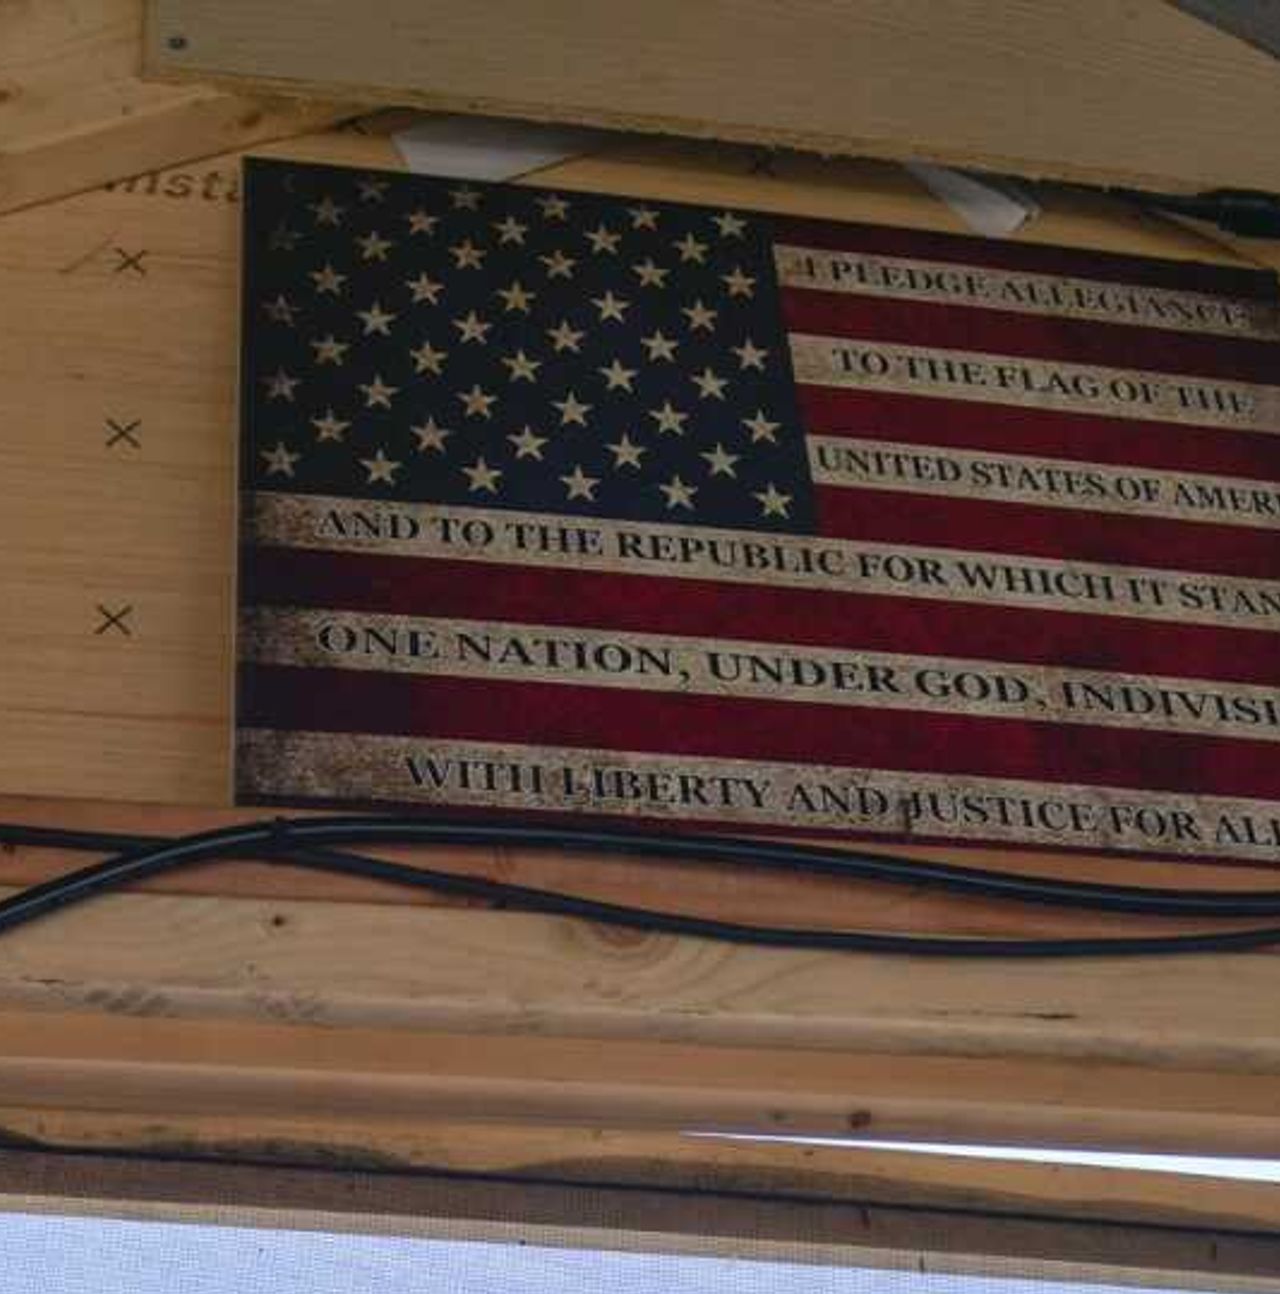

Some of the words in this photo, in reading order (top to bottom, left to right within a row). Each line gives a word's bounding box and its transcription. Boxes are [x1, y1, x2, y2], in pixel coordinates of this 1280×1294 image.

[831, 259, 988, 300] PLEDGE
[1001, 278, 1253, 327] ALLEGIANCE
[832, 346, 889, 375] TO
[893, 353, 987, 387] THE
[996, 363, 1099, 398] FLAG
[1110, 379, 1163, 405] OF
[1174, 384, 1255, 416] THE
[816, 446, 962, 483] UNITED
[970, 462, 1106, 497] STATES
[1115, 478, 1163, 503] OF
[316, 507, 419, 541] AND
[436, 517, 494, 547] TO
[505, 521, 602, 555] THE
[617, 531, 846, 577] REPUBLIC
[859, 554, 945, 587] FOR
[958, 560, 1117, 605] WHICH
[1128, 578, 1166, 607] IT
[317, 622, 439, 659] ONE
[457, 631, 693, 685] NATION,
[708, 652, 898, 695] UNDER
[914, 669, 1048, 710] GOD,
[404, 756, 544, 793] WITH
[563, 766, 772, 808] LIBERTY
[786, 783, 889, 817] AND
[905, 790, 1097, 833] JUSTICE
[1111, 810, 1200, 842] FOR
